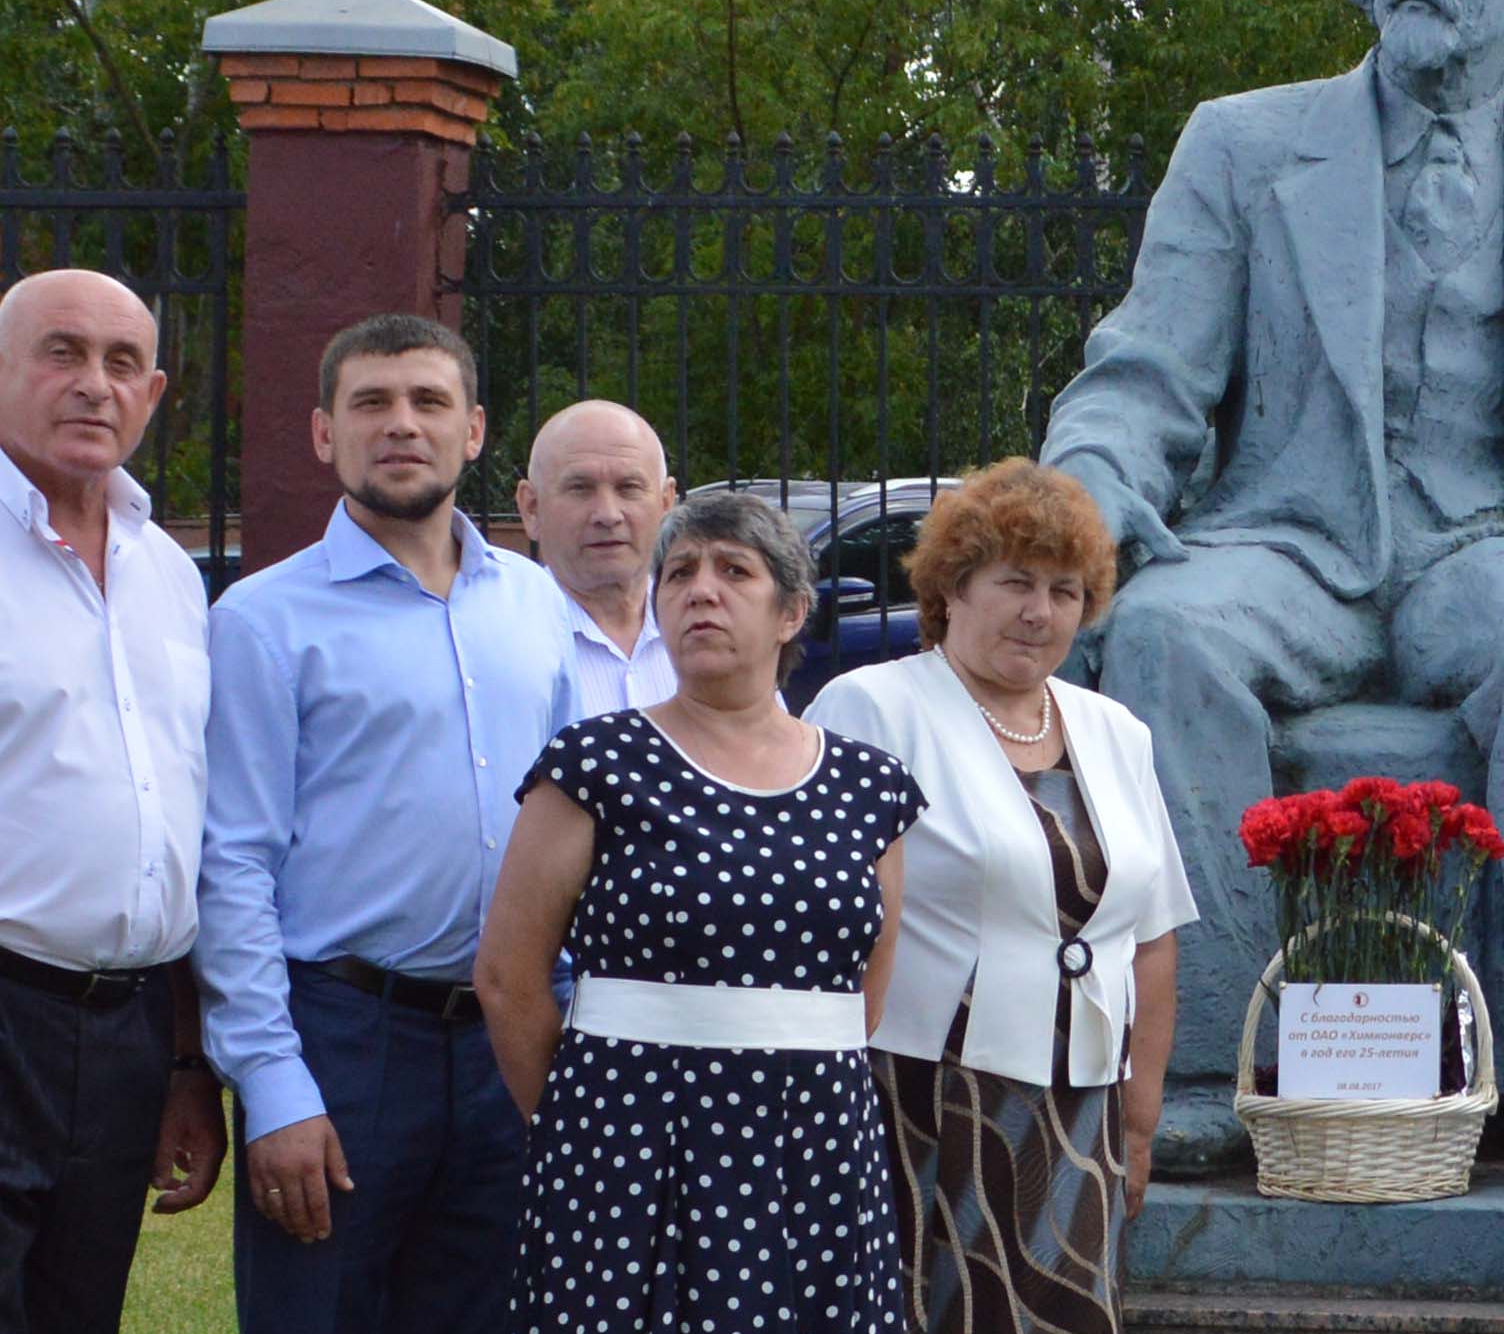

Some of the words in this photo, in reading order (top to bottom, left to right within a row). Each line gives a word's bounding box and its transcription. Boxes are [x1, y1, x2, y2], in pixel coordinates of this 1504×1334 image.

[1300, 1012, 1308, 1024] С
[1310, 1011, 1420, 1025] благодарностью
[1288, 1033, 1308, 1041] от
[1310, 1030, 1338, 1041] ОАО
[1300, 1050, 1308, 1058] в
[1310, 1047, 1333, 1059] год
[1335, 1049, 1355, 1059] его
[1359, 1047, 1419, 1059] 25-летия
